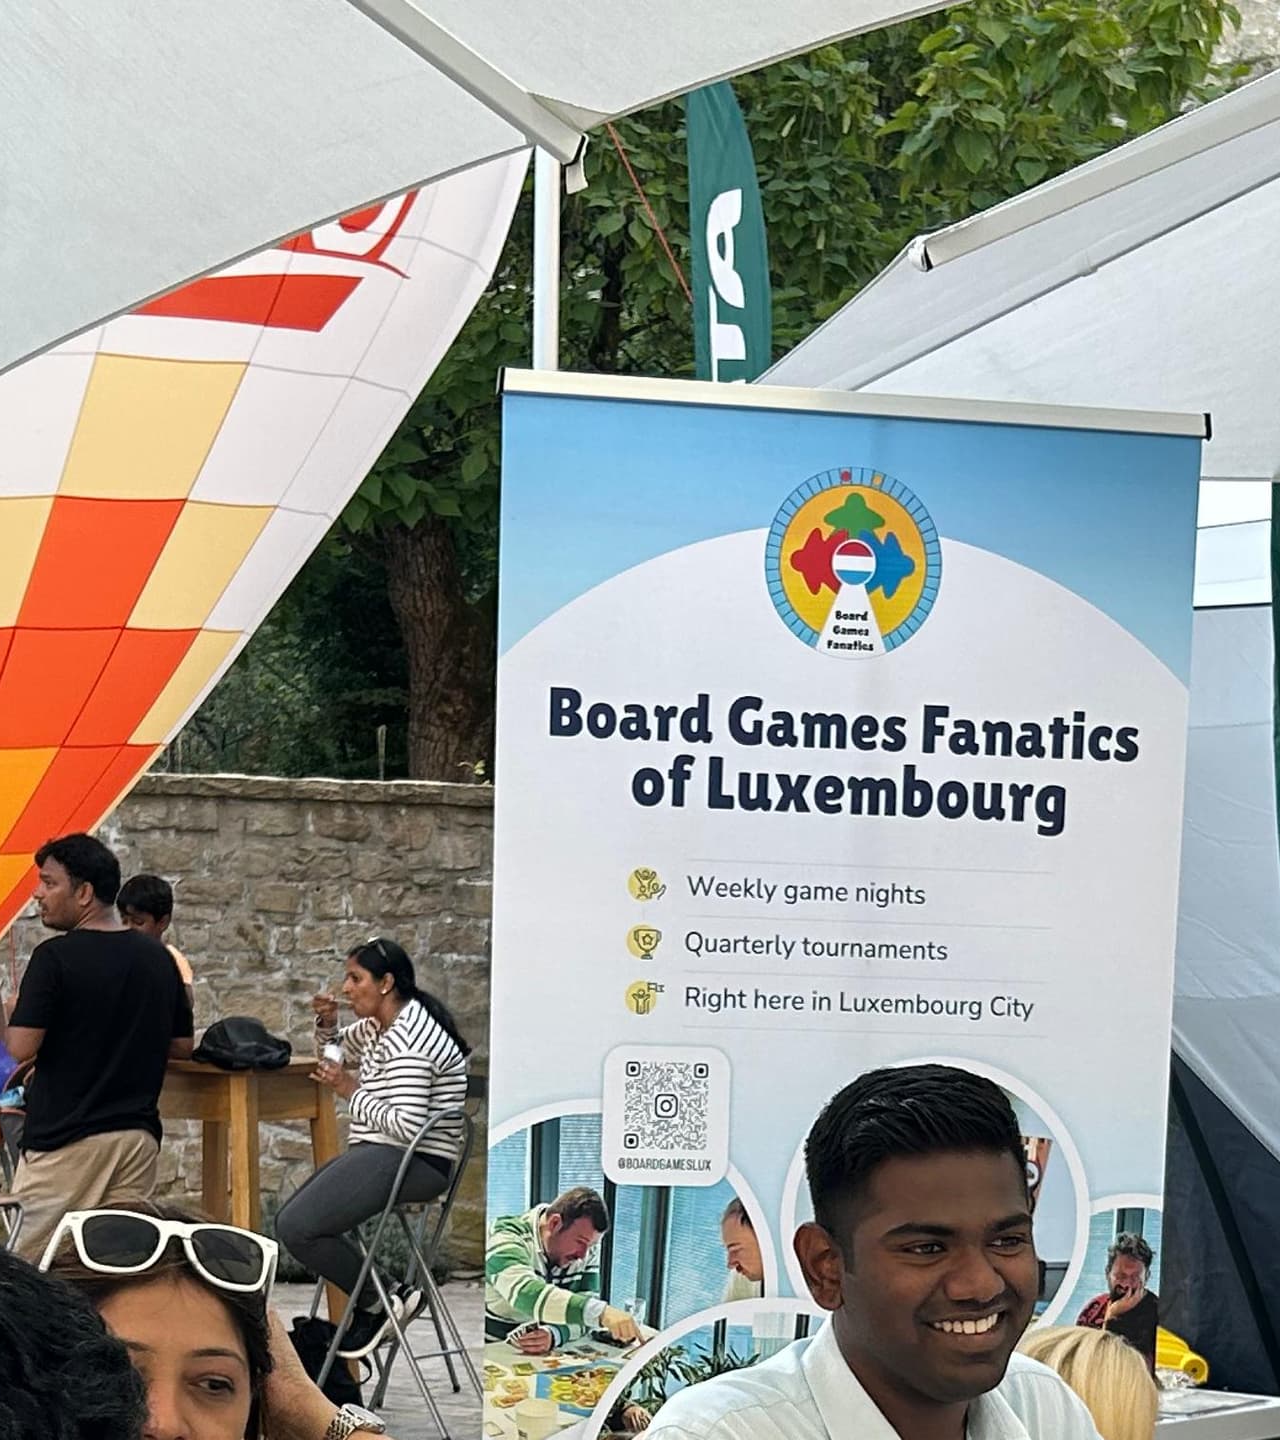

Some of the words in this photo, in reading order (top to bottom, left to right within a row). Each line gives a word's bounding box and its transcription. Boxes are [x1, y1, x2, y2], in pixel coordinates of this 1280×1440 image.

[835, 610, 868, 621] Board
[832, 625, 869, 636] Games
[827, 640, 874, 652] Fanatics
[549, 687, 712, 744] Board
[728, 696, 906, 751] Games
[922, 705, 1139, 762] Fanatics
[632, 755, 695, 808] of
[707, 756, 1066, 837] Luxembourg
[687, 875, 776, 902] Weekly
[784, 885, 848, 905] game
[856, 882, 926, 908] nights
[685, 931, 796, 960] Quarterly
[802, 936, 948, 960] tournaments
[685, 986, 747, 1013] Right
[754, 988, 804, 1010] here
[812, 990, 832, 1011] in
[839, 992, 982, 1020] Luxembourg
[990, 995, 1034, 1022] City
[618, 1157, 711, 1171] @BOARDGAMESLUX
